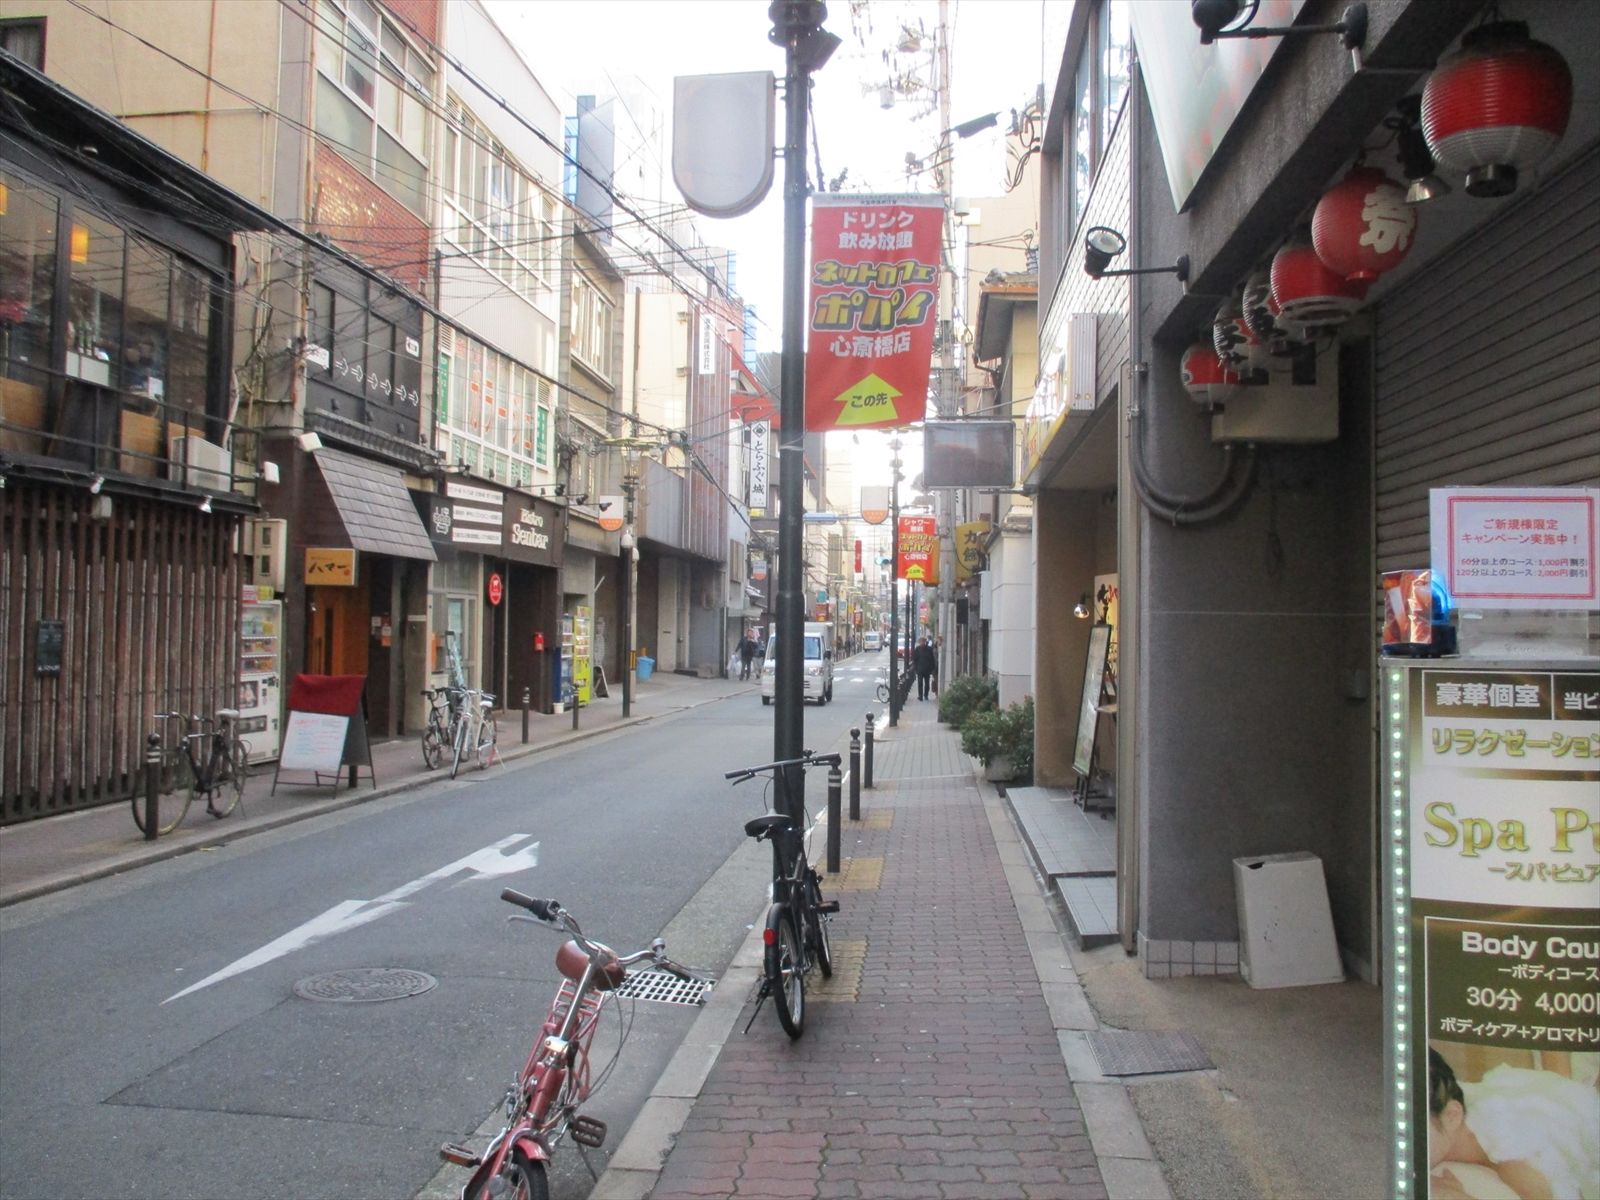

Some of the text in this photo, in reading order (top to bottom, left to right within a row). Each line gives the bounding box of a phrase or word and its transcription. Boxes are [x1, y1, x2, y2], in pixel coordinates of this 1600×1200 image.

[842, 211, 914, 229] ドリンク
[838, 231, 914, 250] 飲み放題
[814, 261, 936, 287] ネットカフェ
[813, 289, 933, 331] ポパイ
[850, 392, 888, 408] この先
[752, 441, 766, 495] とらふぐ城
[1483, 518, 1559, 530] ご新規様限定
[1436, 682, 1541, 708] 豪華個室
[1424, 801, 1530, 857] Spa
[1461, 931, 1600, 960] Body Cou
[1466, 986, 1600, 1015] 30分 4,000
